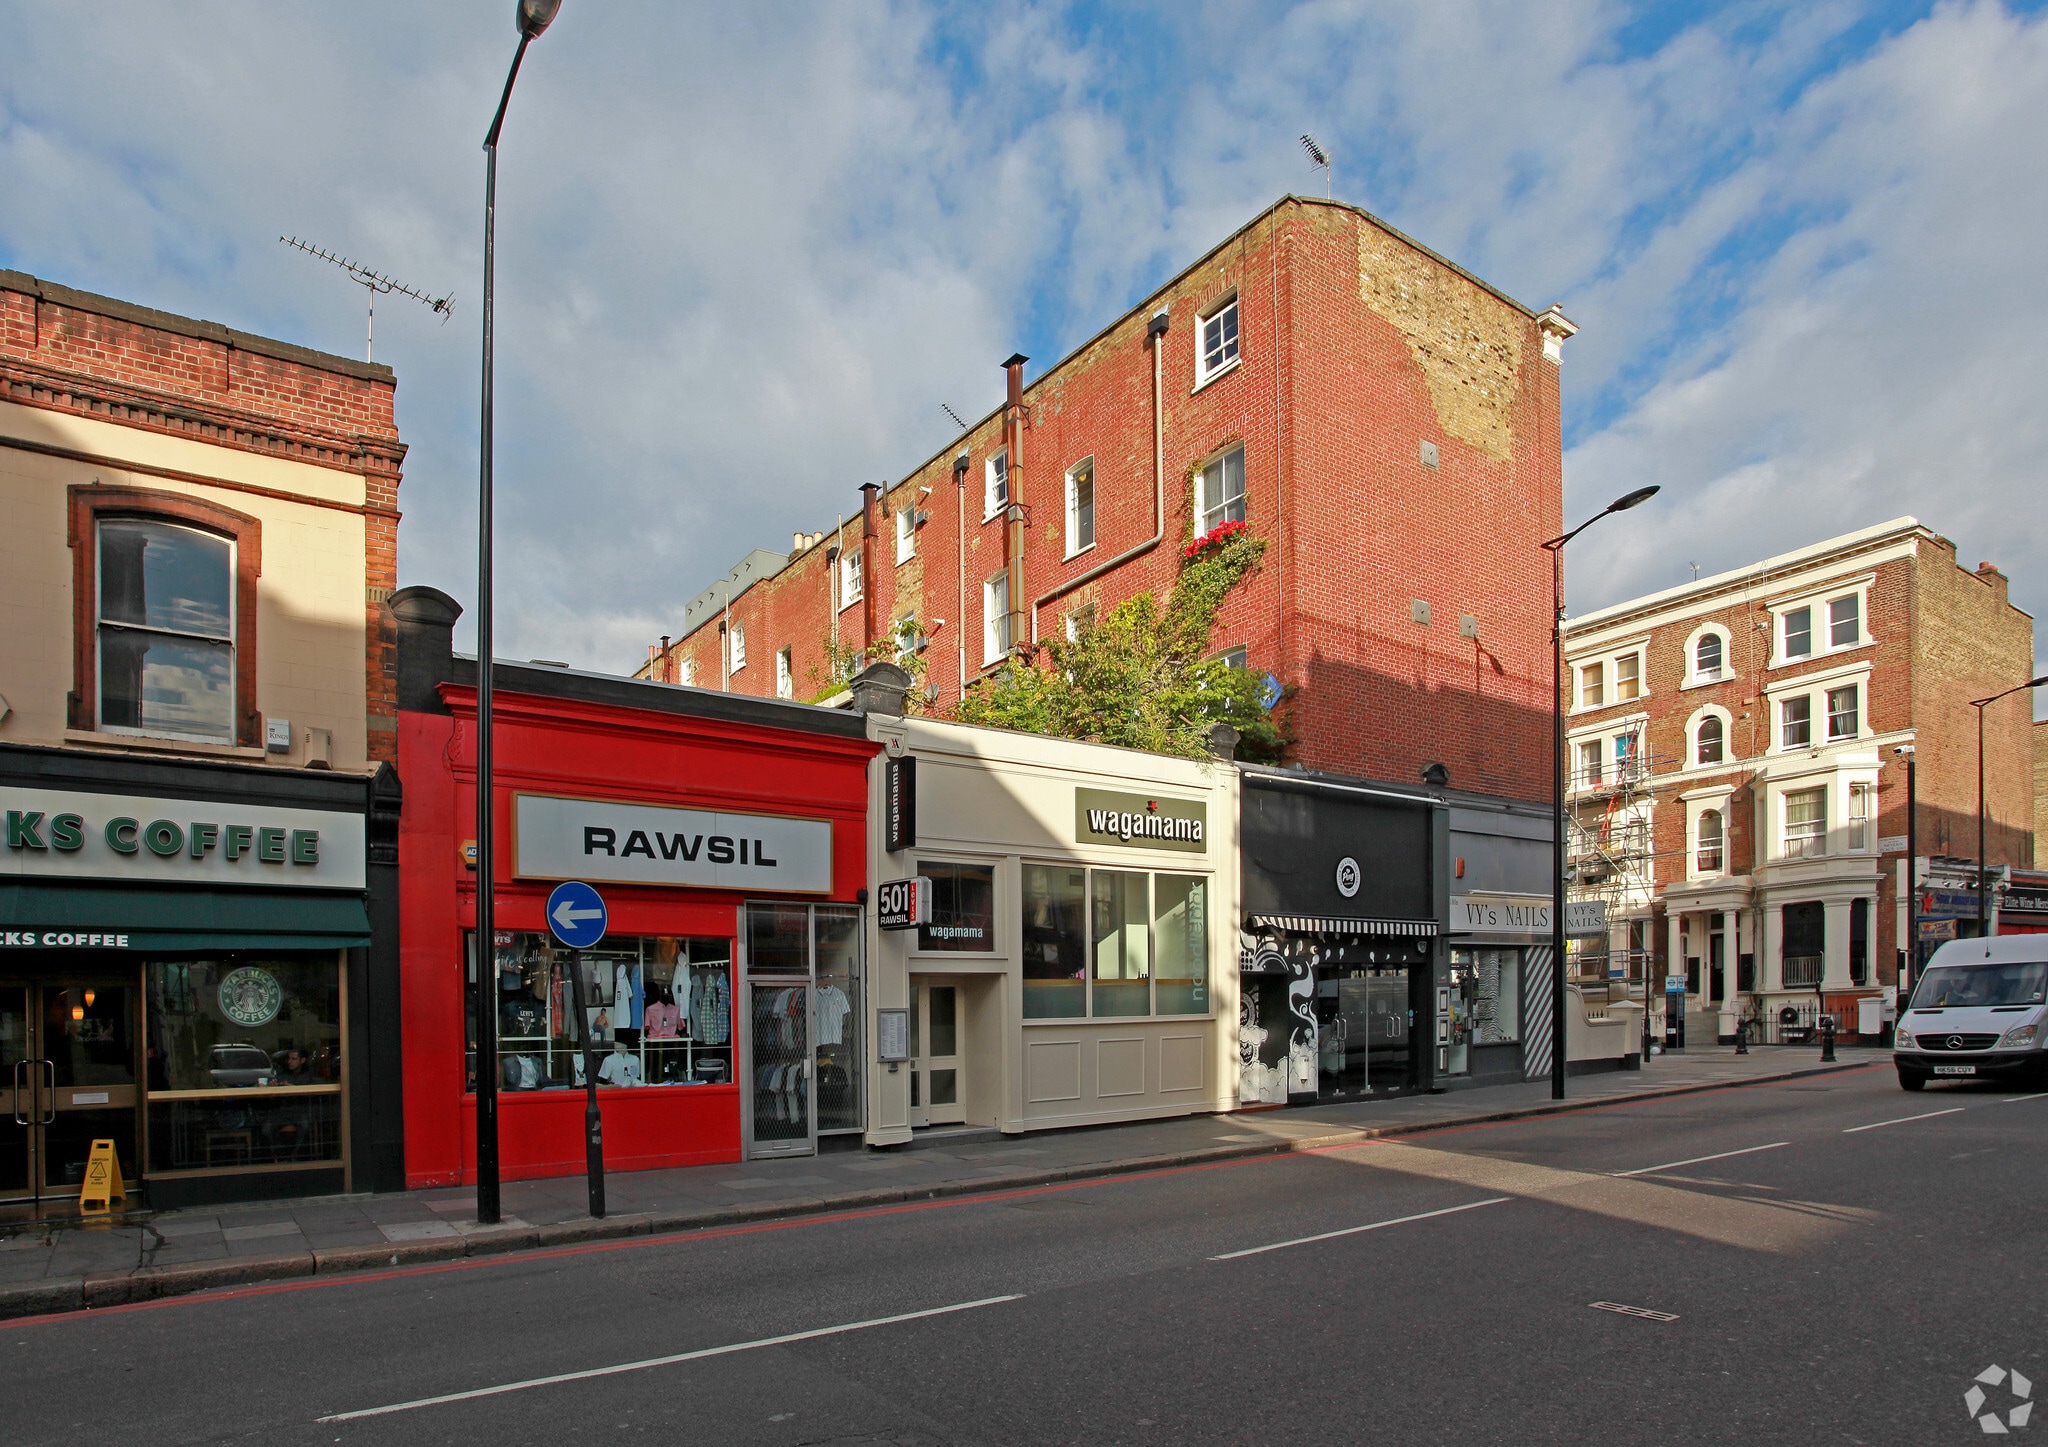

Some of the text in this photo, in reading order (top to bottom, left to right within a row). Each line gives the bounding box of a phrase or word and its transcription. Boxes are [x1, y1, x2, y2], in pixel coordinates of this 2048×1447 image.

[1089, 808, 1203, 840] wagamama
[6, 809, 320, 865] KS COFFEE
[583, 825, 778, 868] RAWSIL
[880, 883, 909, 914] 501
[880, 914, 908, 925] RAWSIL
[1466, 903, 1549, 928] VY's NAILS
[1573, 905, 1596, 916] VY's
[1567, 916, 1602, 929] NAILS
[0, 931, 129, 947] KS COFFEE
[929, 926, 984, 940] wagamama
[223, 969, 278, 995] STARBUCKS
[228, 1006, 272, 1022] COFFEE
